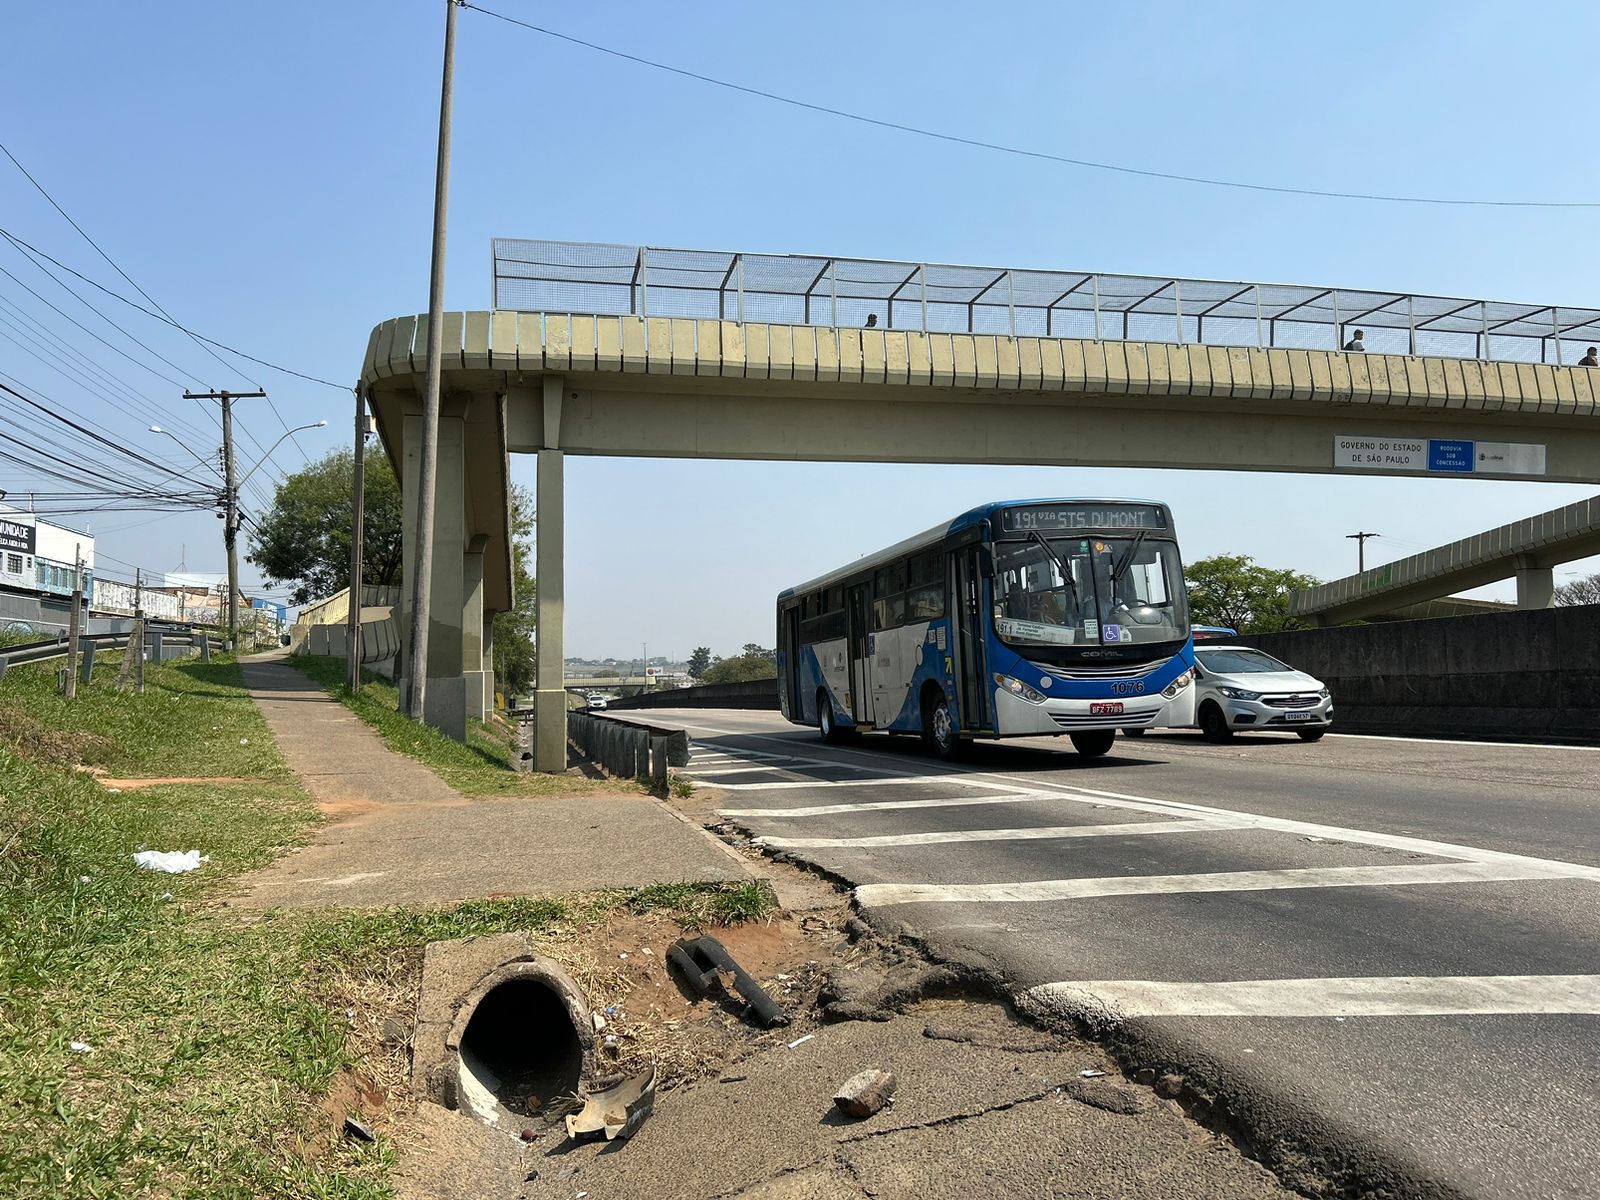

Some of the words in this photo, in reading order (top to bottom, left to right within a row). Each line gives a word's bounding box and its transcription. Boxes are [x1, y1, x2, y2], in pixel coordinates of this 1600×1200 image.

[1340, 441, 1375, 450] GOVERNO
[1379, 442, 1389, 451] DO
[1393, 443, 1422, 452] ESTADO
[1352, 454, 1362, 462] DE
[1385, 455, 1410, 464] PAULO
[1015, 512, 1038, 529] 191
[1038, 512, 1056, 520] VIA
[1091, 511, 1146, 528] DUMONT
[1111, 681, 1144, 694] 1076
